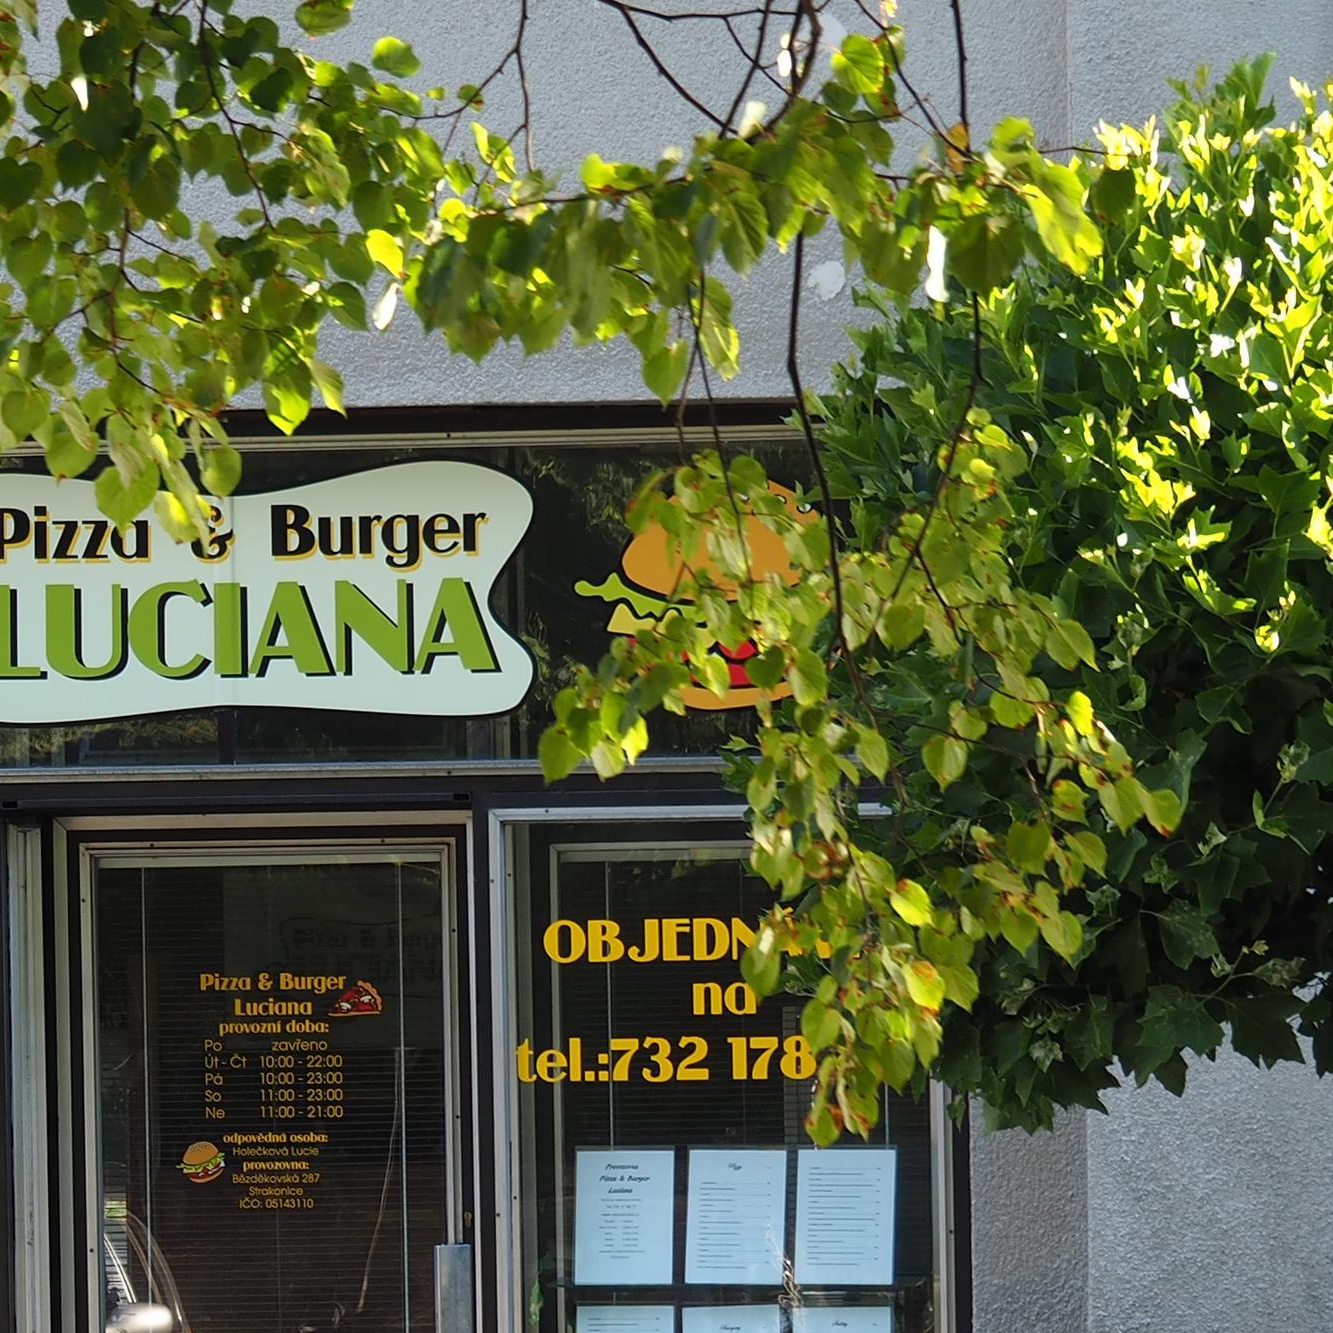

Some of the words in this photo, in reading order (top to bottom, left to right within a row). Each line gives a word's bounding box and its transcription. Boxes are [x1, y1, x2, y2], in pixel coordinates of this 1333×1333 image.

[270, 503, 487, 568] Burger
[199, 973, 252, 991] Pizza
[257, 972, 273, 991] &
[279, 973, 347, 994] Burger
[692, 981, 757, 1015] na
[234, 998, 313, 1017] Luciana
[219, 1020, 282, 1036] provozní
[286, 1019, 330, 1034] doba:
[204, 1039, 223, 1052] Po
[271, 1038, 328, 1052] zavřeno
[204, 1053, 220, 1069] Út
[229, 1053, 247, 1069] Čt
[260, 1055, 295, 1069] 10:00
[306, 1054, 343, 1068] 22:00
[726, 1035, 817, 1080] 178
[204, 1072, 224, 1086] Pá
[260, 1072, 295, 1085] 10:00
[306, 1071, 343, 1084] 23:00
[204, 1089, 222, 1103] So
[260, 1088, 295, 1102] 11:00
[306, 1088, 344, 1101] 23:00
[205, 1107, 225, 1120] Ne
[260, 1106, 295, 1119] 11:00
[306, 1105, 344, 1118] 21:00
[223, 1132, 287, 1146] odpovědná
[289, 1132, 329, 1143] osoba:
[232, 1147, 289, 1157] Holečková
[291, 1147, 320, 1156] Lucie
[243, 1161, 310, 1173] provozovna:
[301, 1173, 321, 1183] 287
[248, 1186, 304, 1197] Strakonice
[265, 1198, 314, 1209] 05143110
